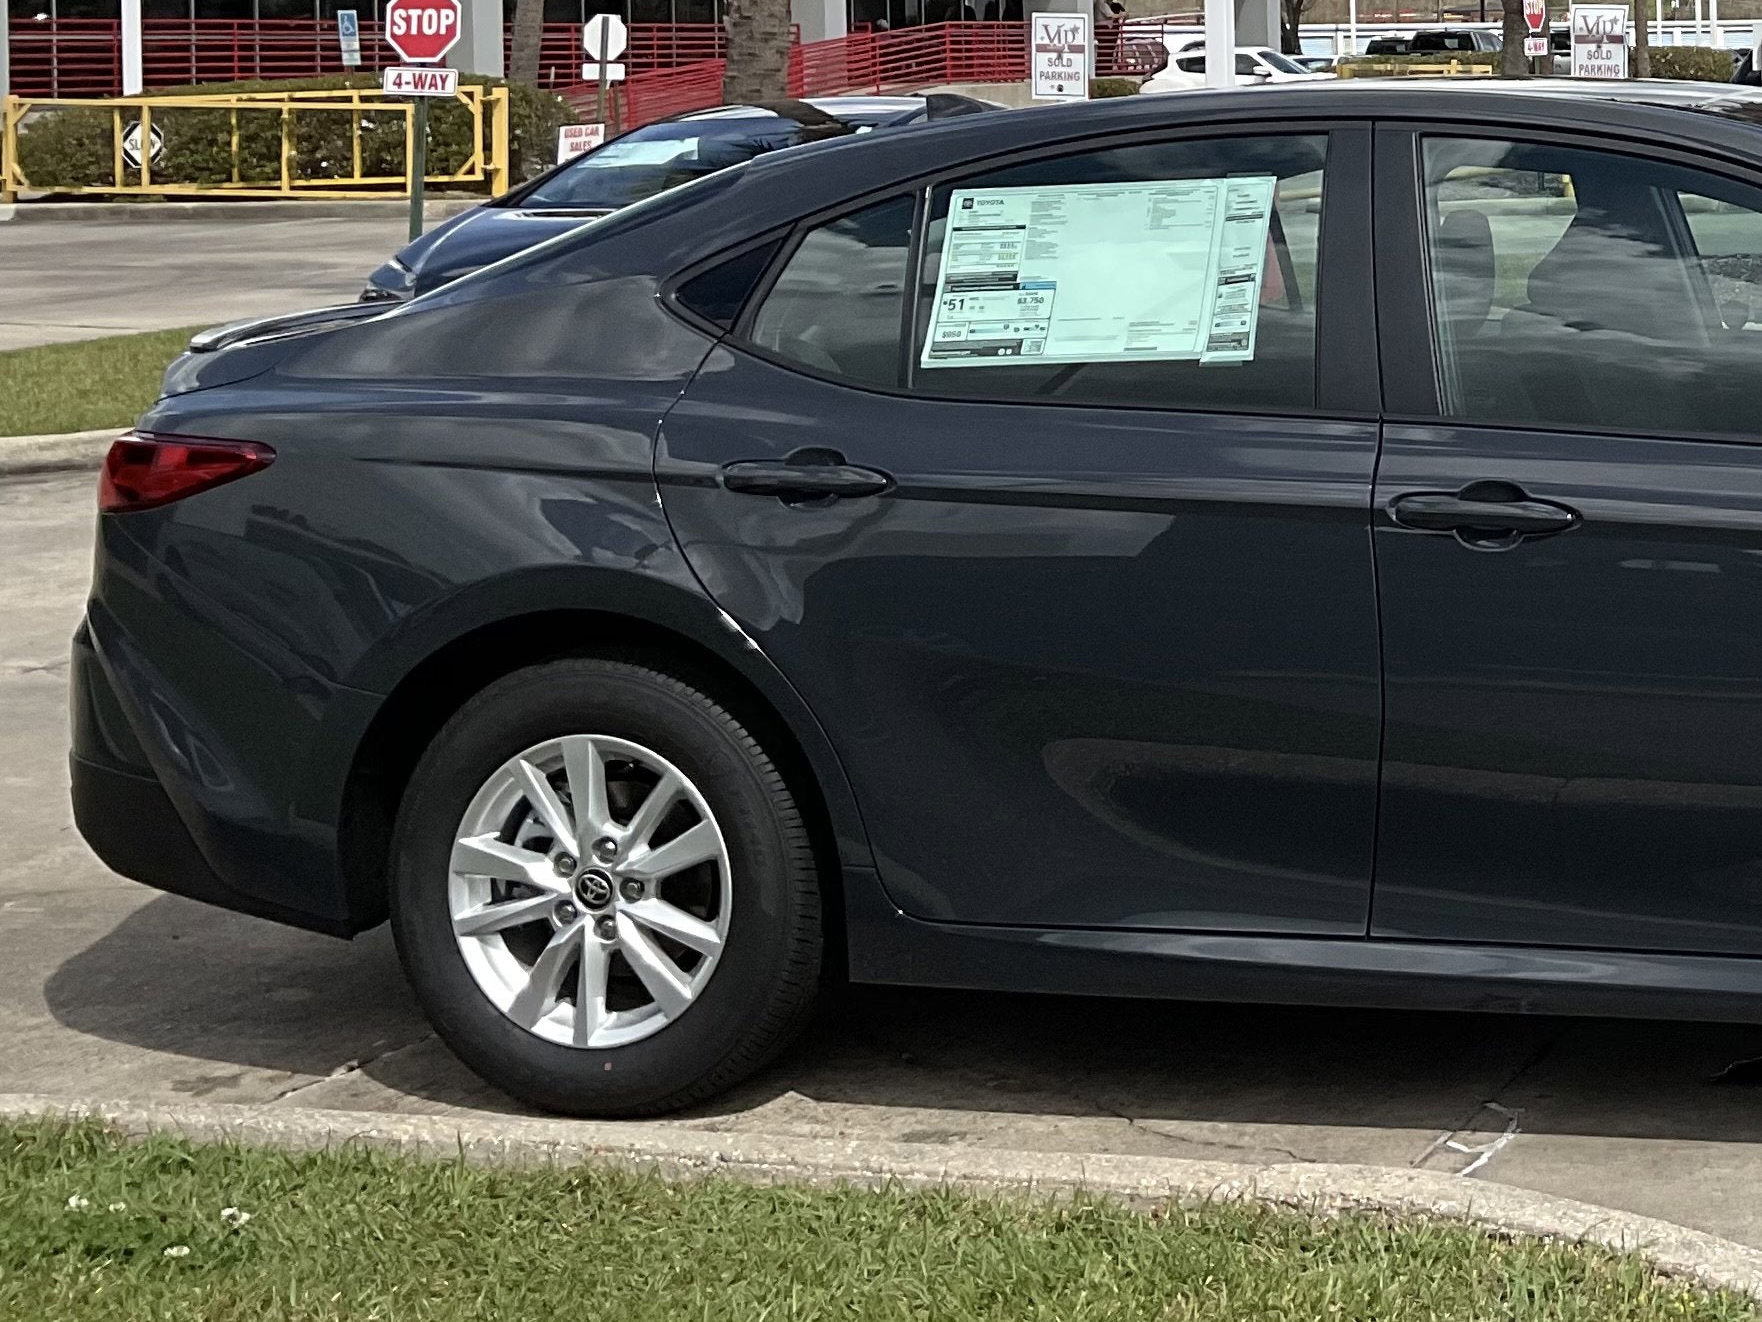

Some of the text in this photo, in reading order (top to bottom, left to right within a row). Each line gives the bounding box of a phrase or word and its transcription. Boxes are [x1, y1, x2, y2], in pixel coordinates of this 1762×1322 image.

[392, 8, 456, 35] STOP
[1586, 50, 1612, 60] SOLD
[1047, 57, 1073, 67] SOLD
[1039, 70, 1081, 81] PARKING
[1578, 64, 1620, 77] PARKING
[392, 72, 450, 90] 4-WAY
[564, 126, 599, 138] USED CAR
[129, 138, 158, 151] SLW
[947, 298, 966, 311] 51
